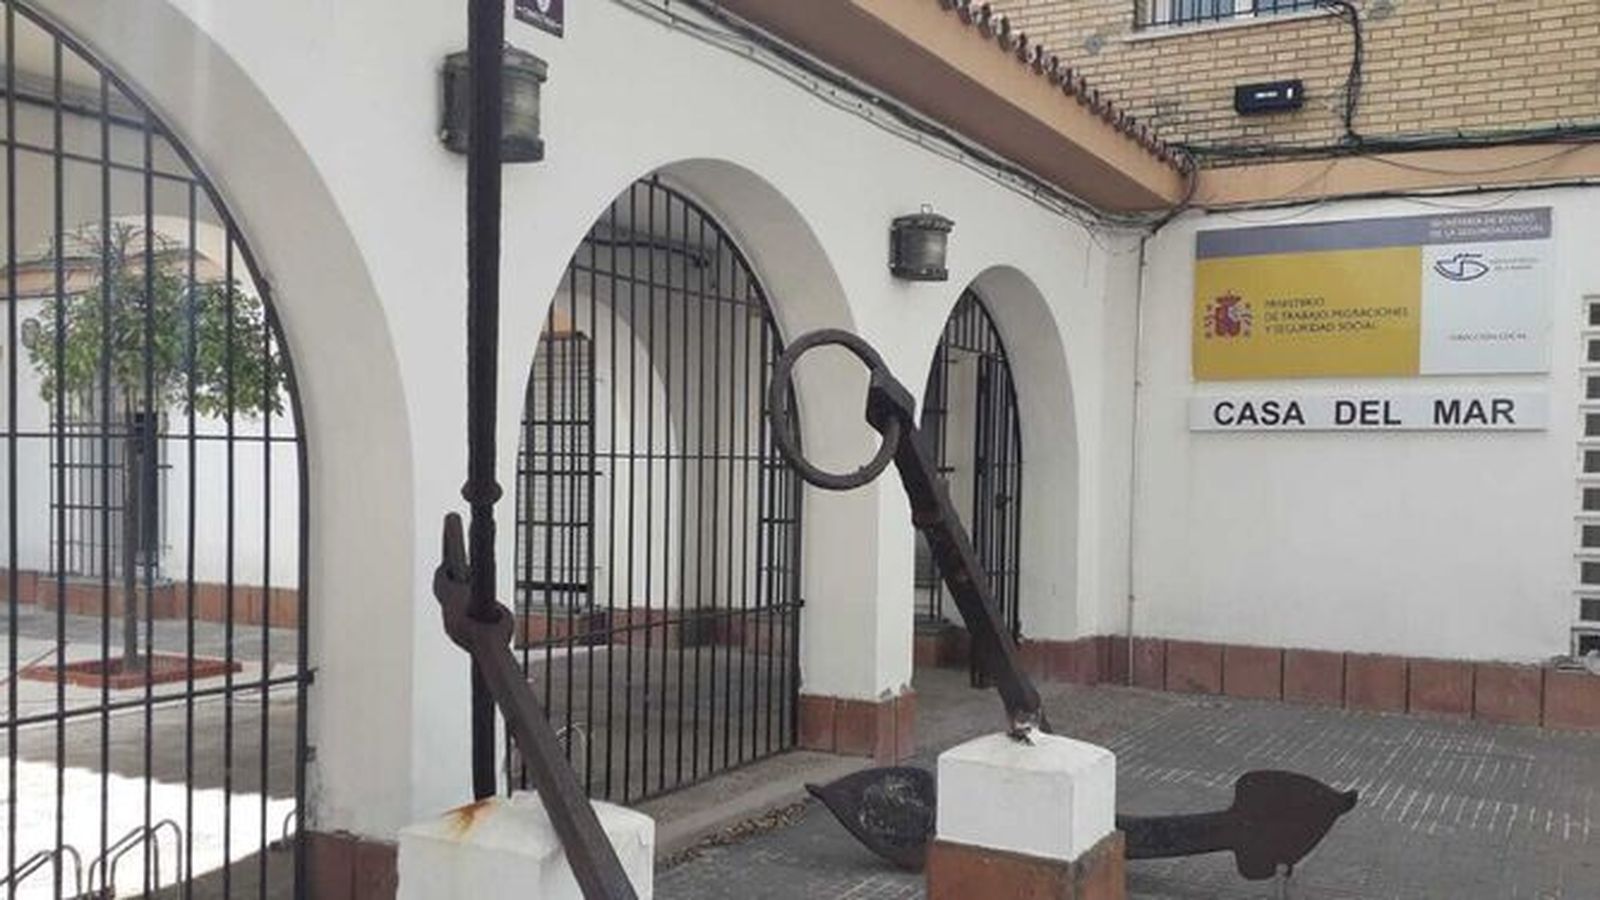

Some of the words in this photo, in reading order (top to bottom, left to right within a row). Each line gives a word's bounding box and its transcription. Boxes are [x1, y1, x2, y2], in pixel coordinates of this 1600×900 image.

[1264, 297, 1325, 309] MINISTERIO
[1264, 311, 1279, 323] DE
[1273, 322, 1335, 335] SEGURIDAD
[1338, 319, 1376, 332] SOCIAL
[1213, 401, 1305, 427] CASA
[1334, 400, 1402, 426] DEL
[1433, 399, 1516, 425] MAR
